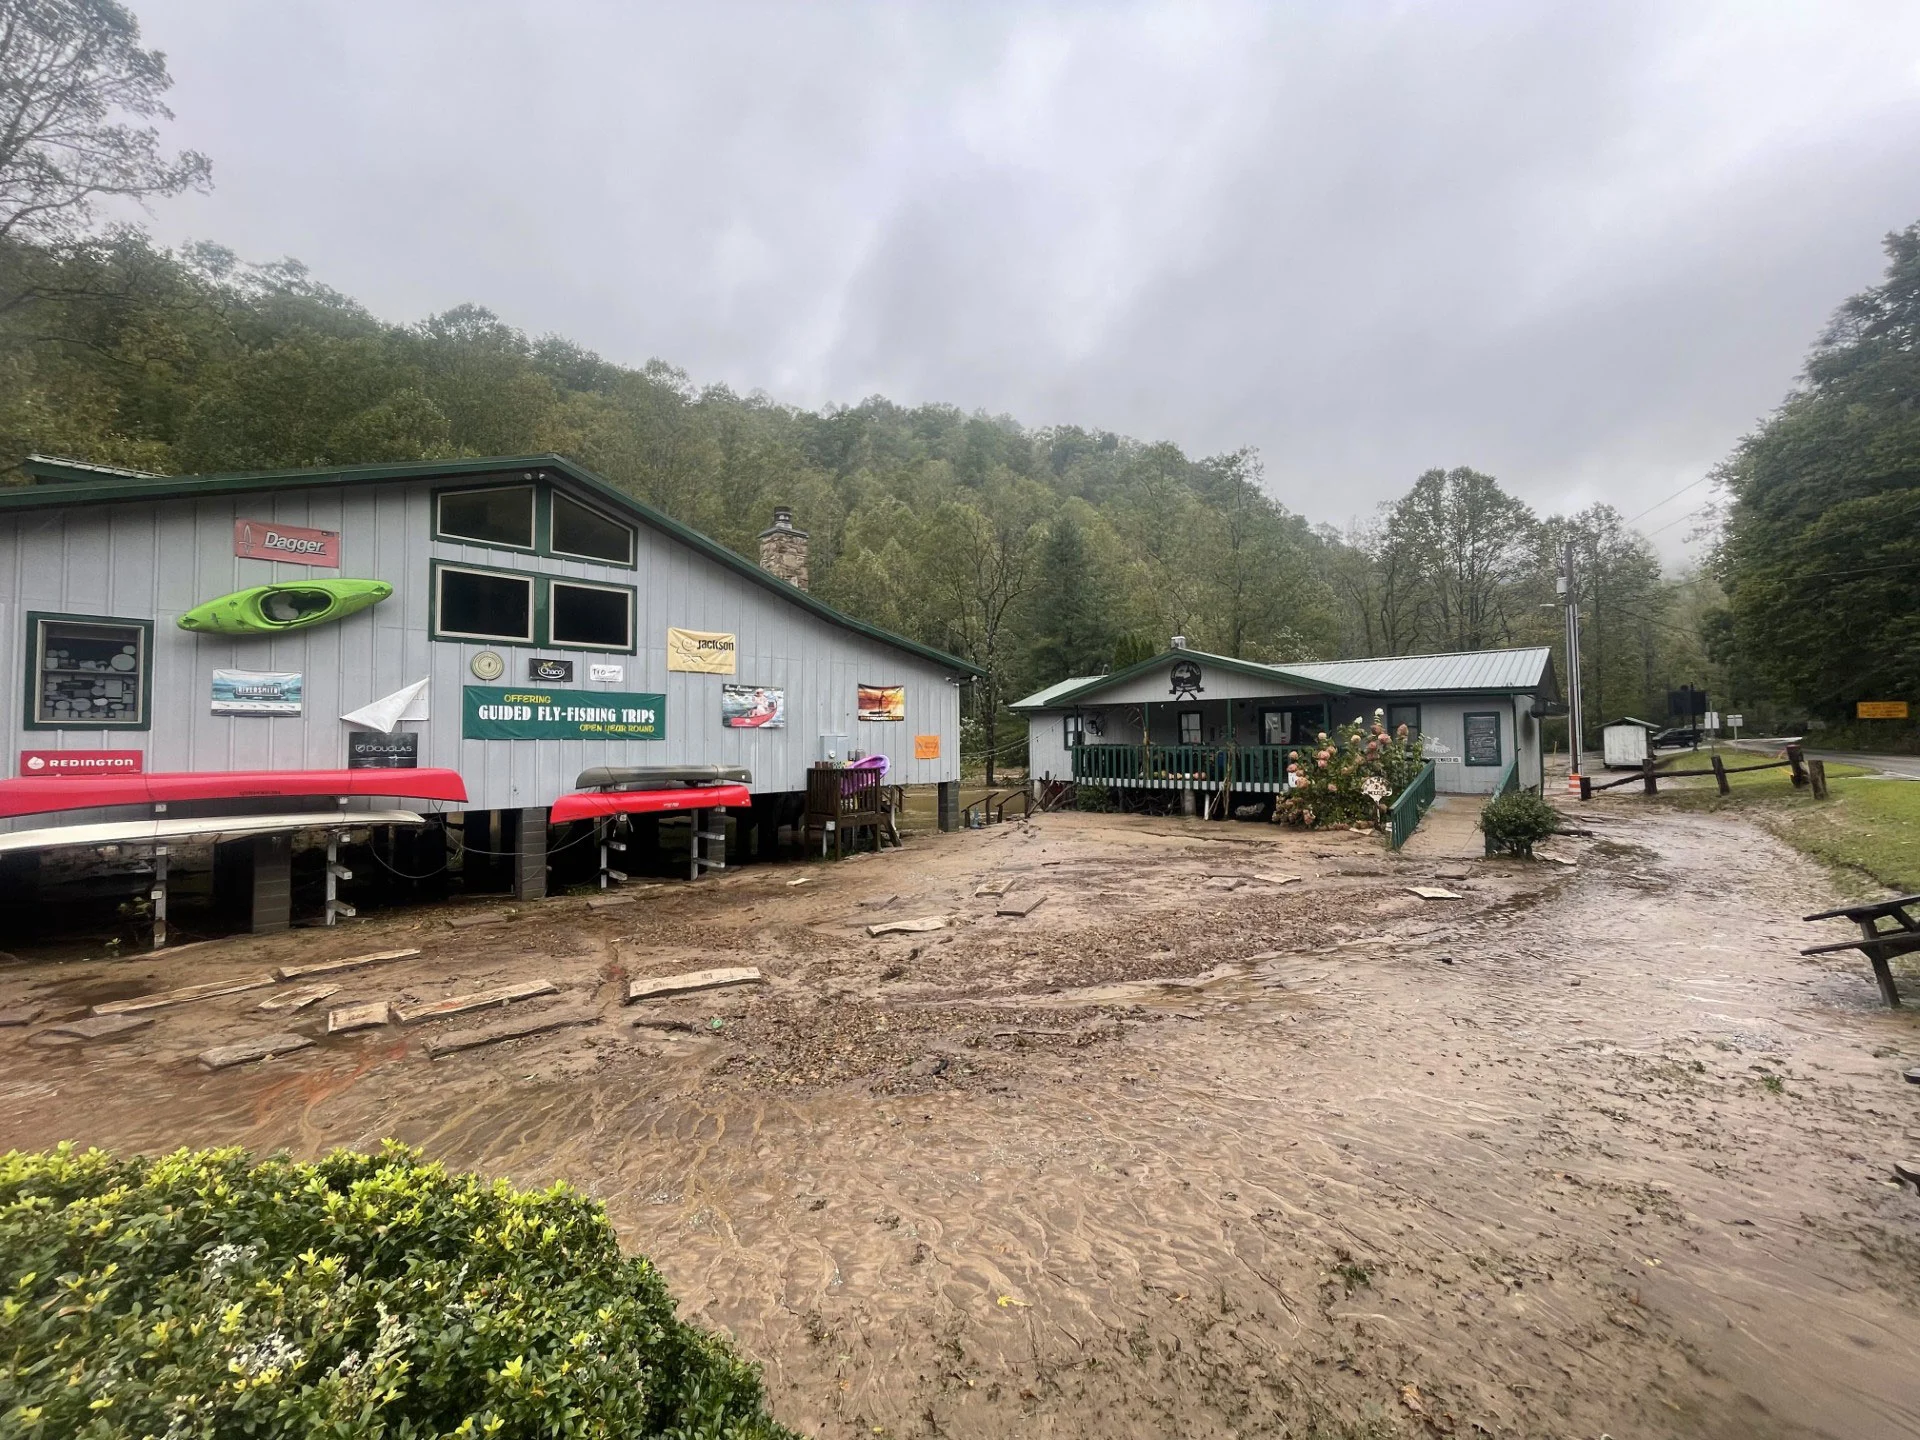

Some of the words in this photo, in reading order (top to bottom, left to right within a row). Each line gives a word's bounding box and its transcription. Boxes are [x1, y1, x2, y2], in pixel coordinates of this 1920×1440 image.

[264, 531, 325, 554] Dagger
[697, 639, 734, 651] Jackson
[540, 666, 563, 675] Chaco
[238, 686, 278, 694] RIVERSMITH
[503, 694, 551, 704] OFFERING
[478, 704, 532, 721] GUIDED
[537, 705, 617, 723] FLY-FISHING
[621, 708, 655, 724] TRIPS
[579, 723, 603, 732] OPEN
[627, 725, 655, 733] ROUND
[49, 759, 134, 767] REDINGTON
